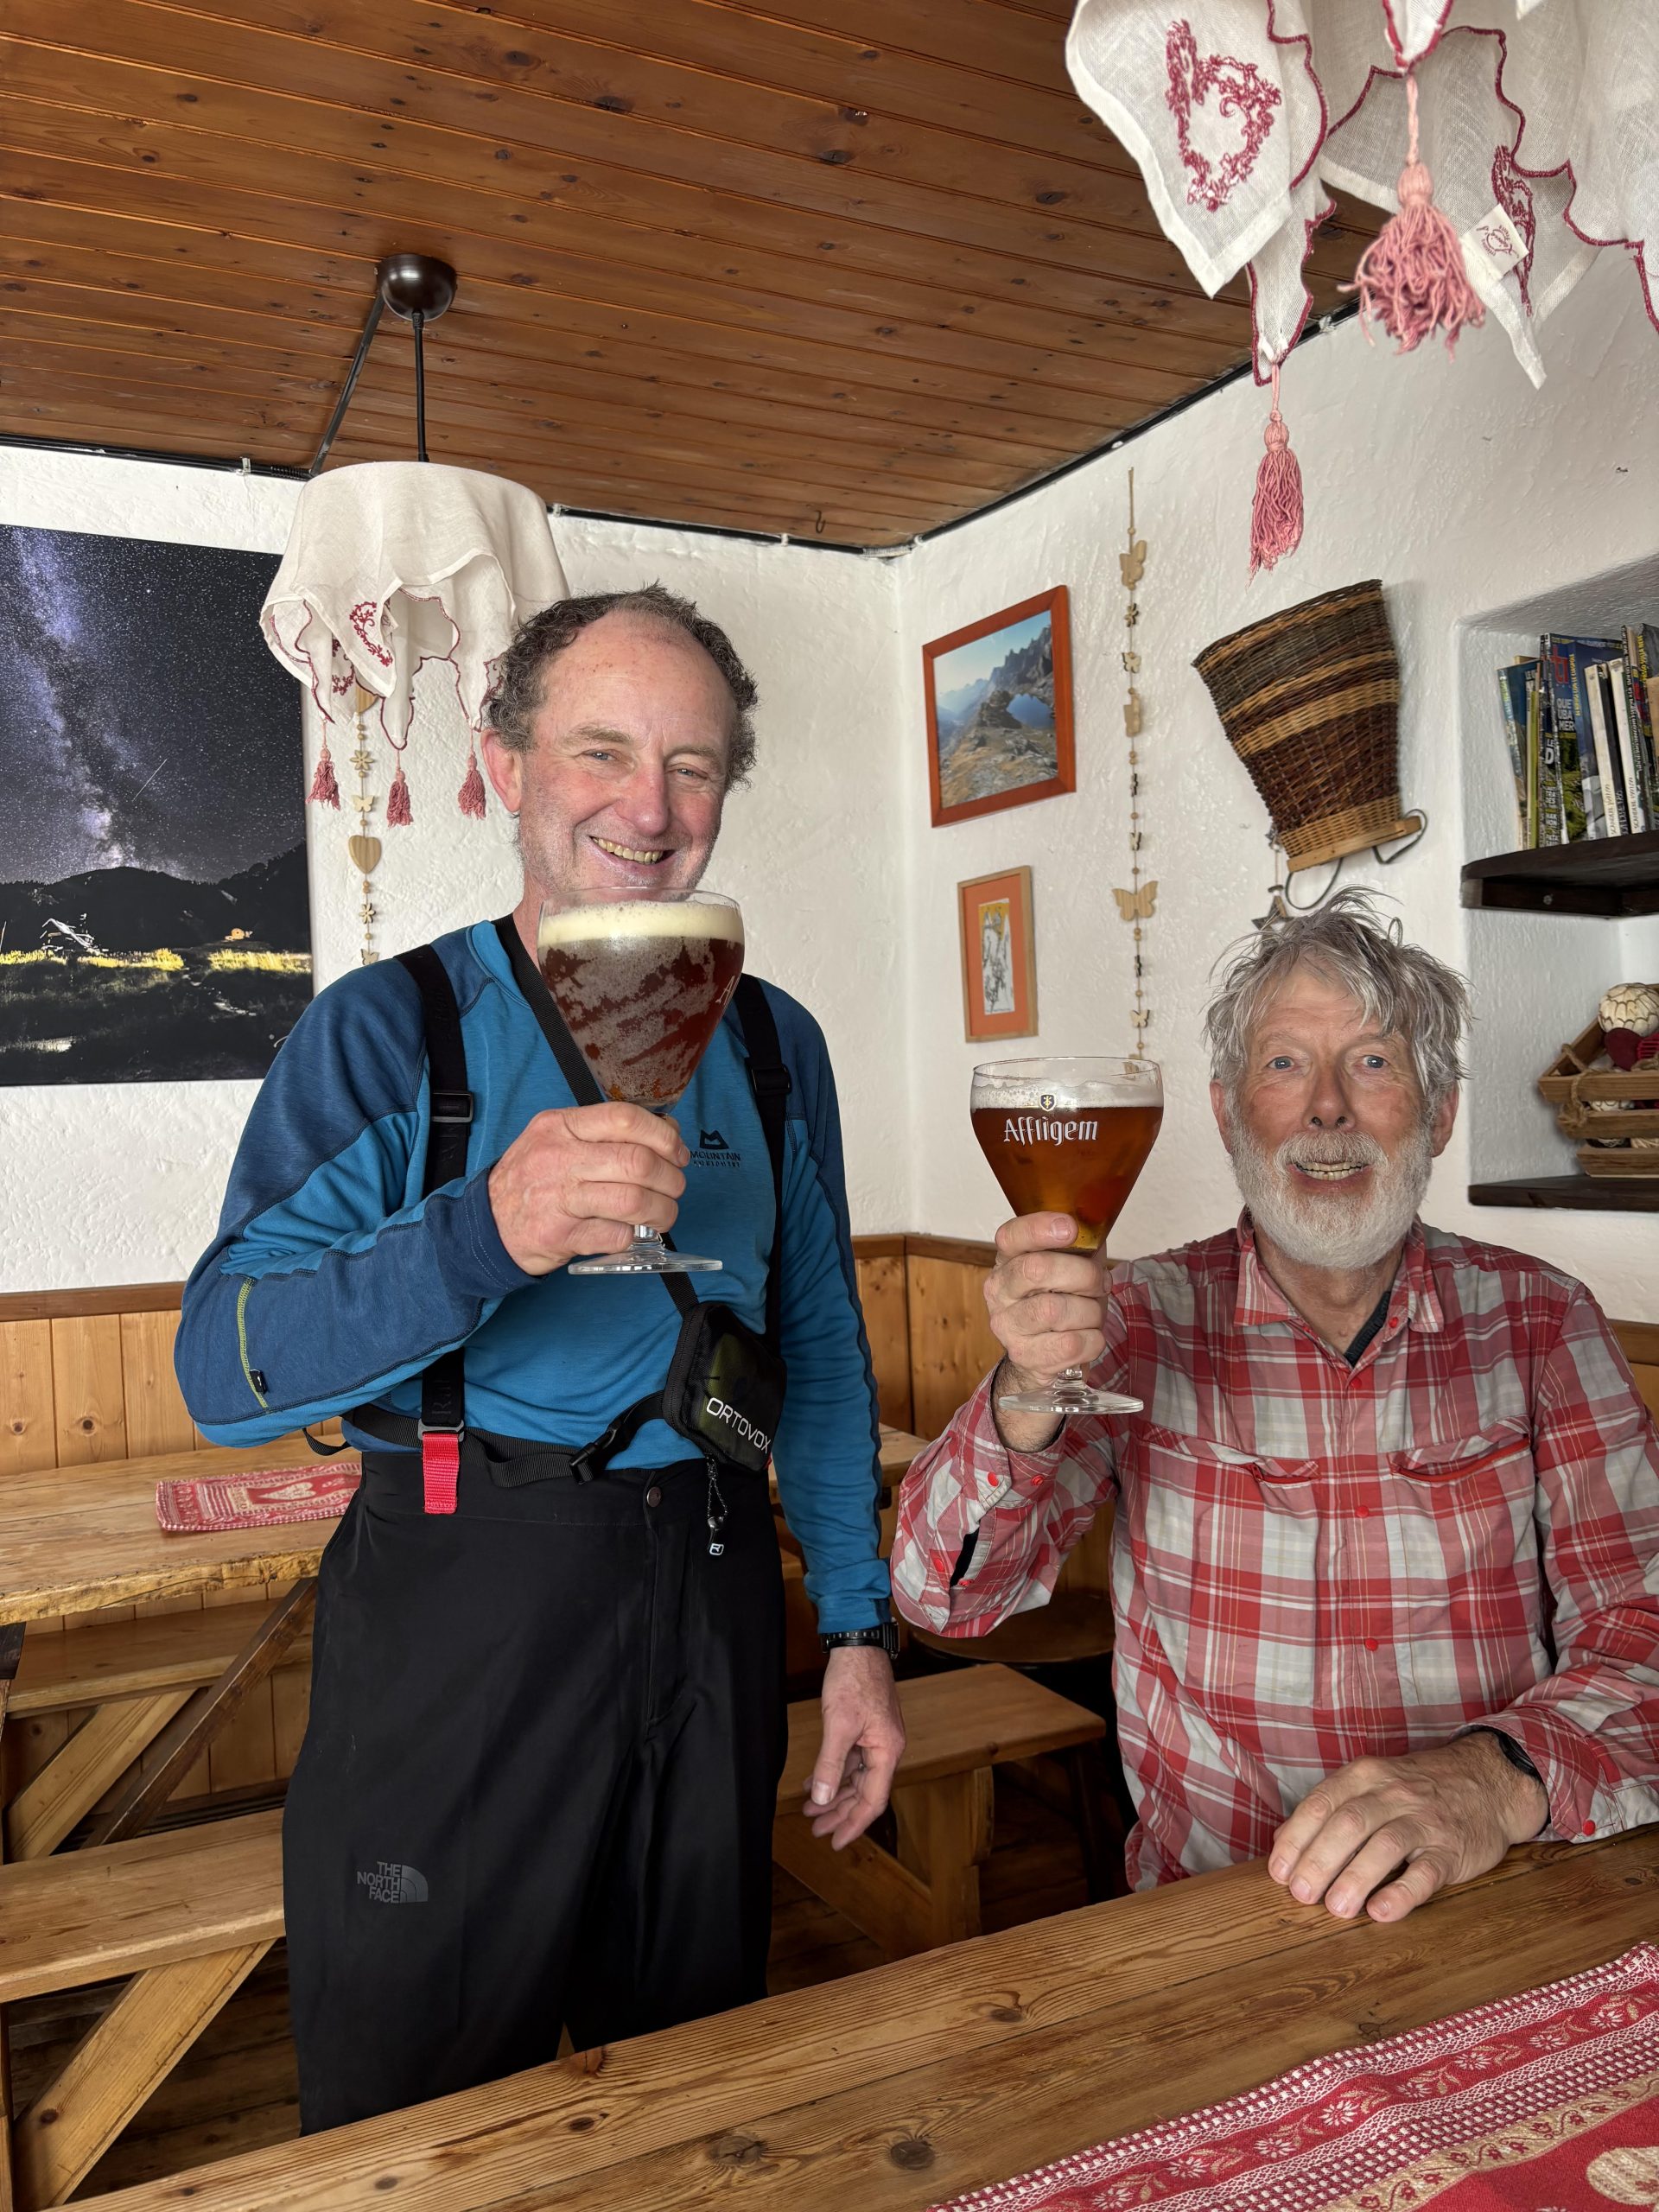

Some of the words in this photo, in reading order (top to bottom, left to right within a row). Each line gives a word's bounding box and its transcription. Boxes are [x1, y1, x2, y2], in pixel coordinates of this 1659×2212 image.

[1003, 1116, 1098, 1146] Affligem
[690, 1150, 741, 1161] MOUNTAIN
[705, 1397, 772, 1454] ORTOVOX
[377, 1861, 401, 1878] THE
[356, 1871, 400, 1891] NORTH
[368, 1886, 400, 1904] FACE
